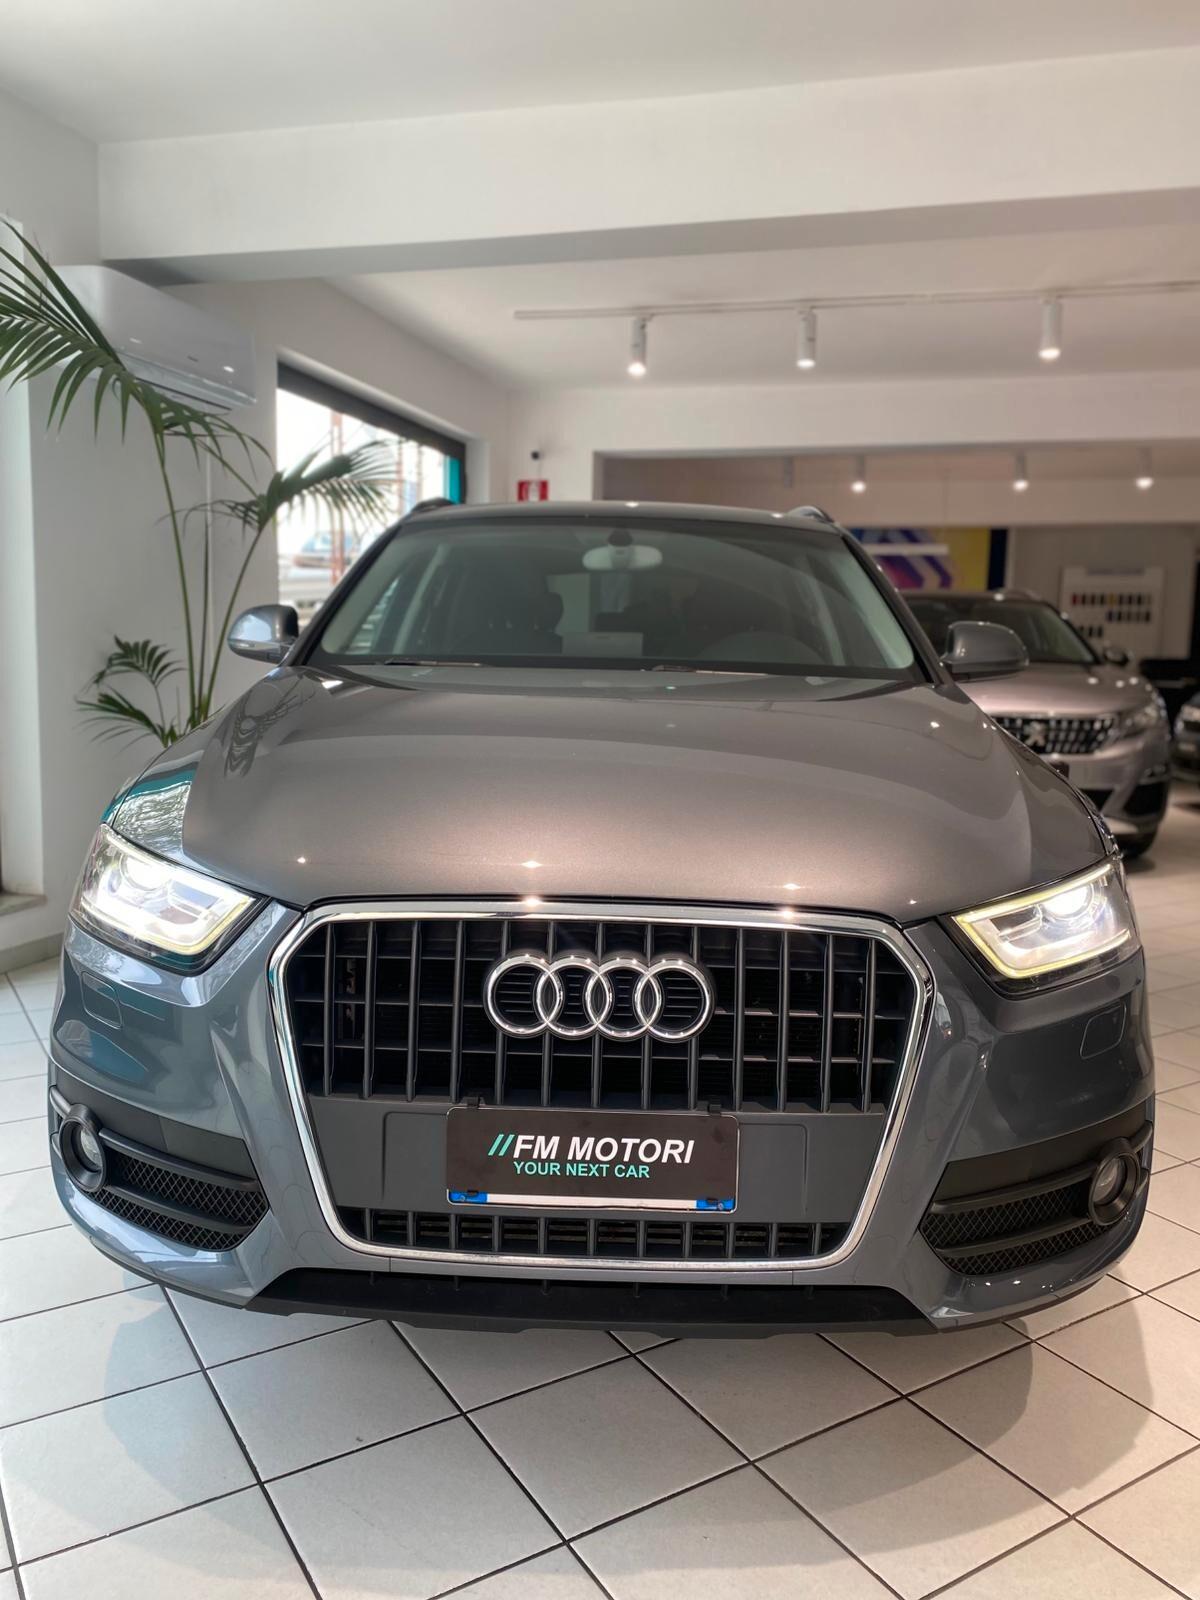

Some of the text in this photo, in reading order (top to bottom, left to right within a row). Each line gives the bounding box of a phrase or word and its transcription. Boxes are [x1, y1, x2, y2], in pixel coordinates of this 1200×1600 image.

[567, 1136, 695, 1164] MOTORI
[513, 1161, 650, 1179] YOUR NEXT CAR
